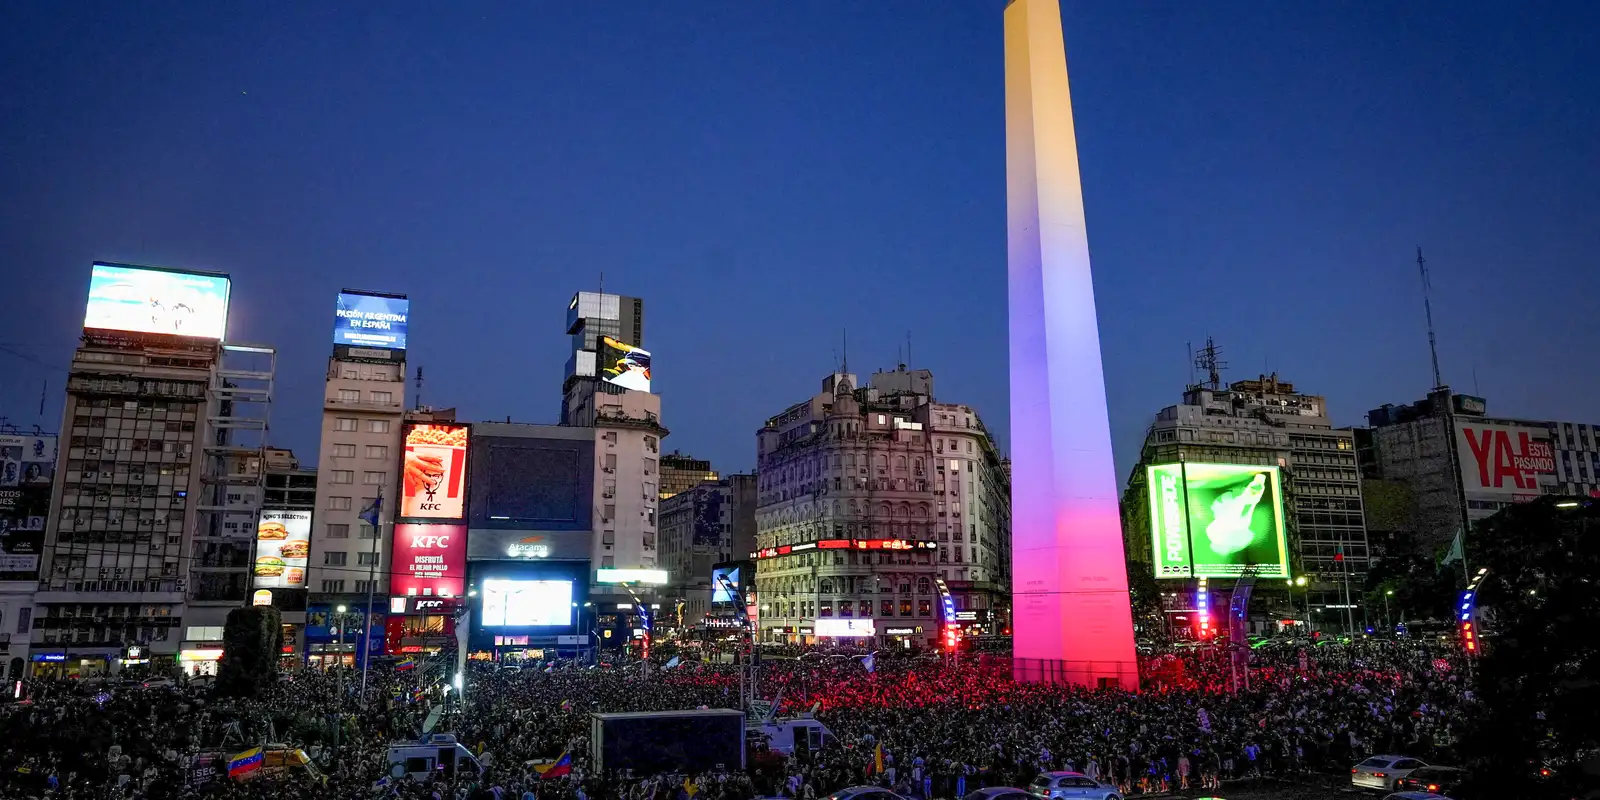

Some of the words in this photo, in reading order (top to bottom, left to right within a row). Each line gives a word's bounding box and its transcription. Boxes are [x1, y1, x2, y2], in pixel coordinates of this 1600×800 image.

[337, 309, 363, 319] PASIÓN
[364, 312, 406, 323] ARGENTINA
[350, 319, 361, 327] EN
[362, 320, 391, 330] ESPAÑA
[1528, 441, 1551, 457] ESTÁ
[1514, 456, 1554, 471] PASANDO
[411, 536, 449, 548] KFC
[508, 543, 548, 551] Atacama
[415, 555, 443, 563] DISFRUTÁ
